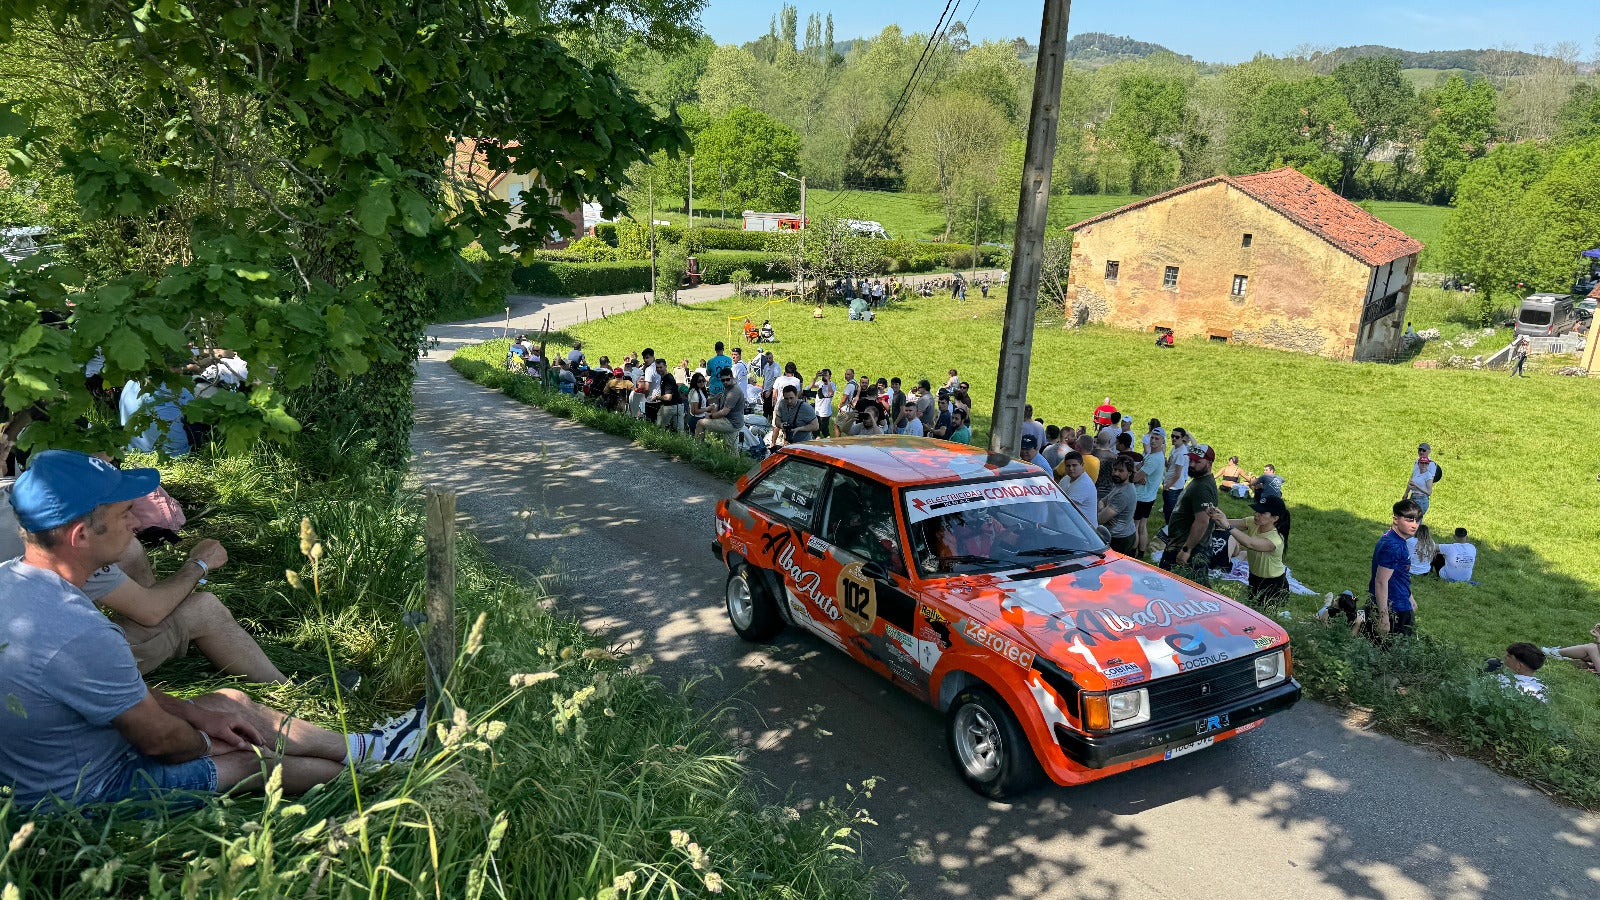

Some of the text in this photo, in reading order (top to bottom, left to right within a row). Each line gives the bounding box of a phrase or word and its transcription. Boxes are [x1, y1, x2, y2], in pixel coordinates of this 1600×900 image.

[926, 490, 982, 505] ELECTRICIDAD
[984, 485, 1050, 500] CONDADO
[843, 577, 870, 620] 102
[1178, 651, 1229, 671] COCENUS
